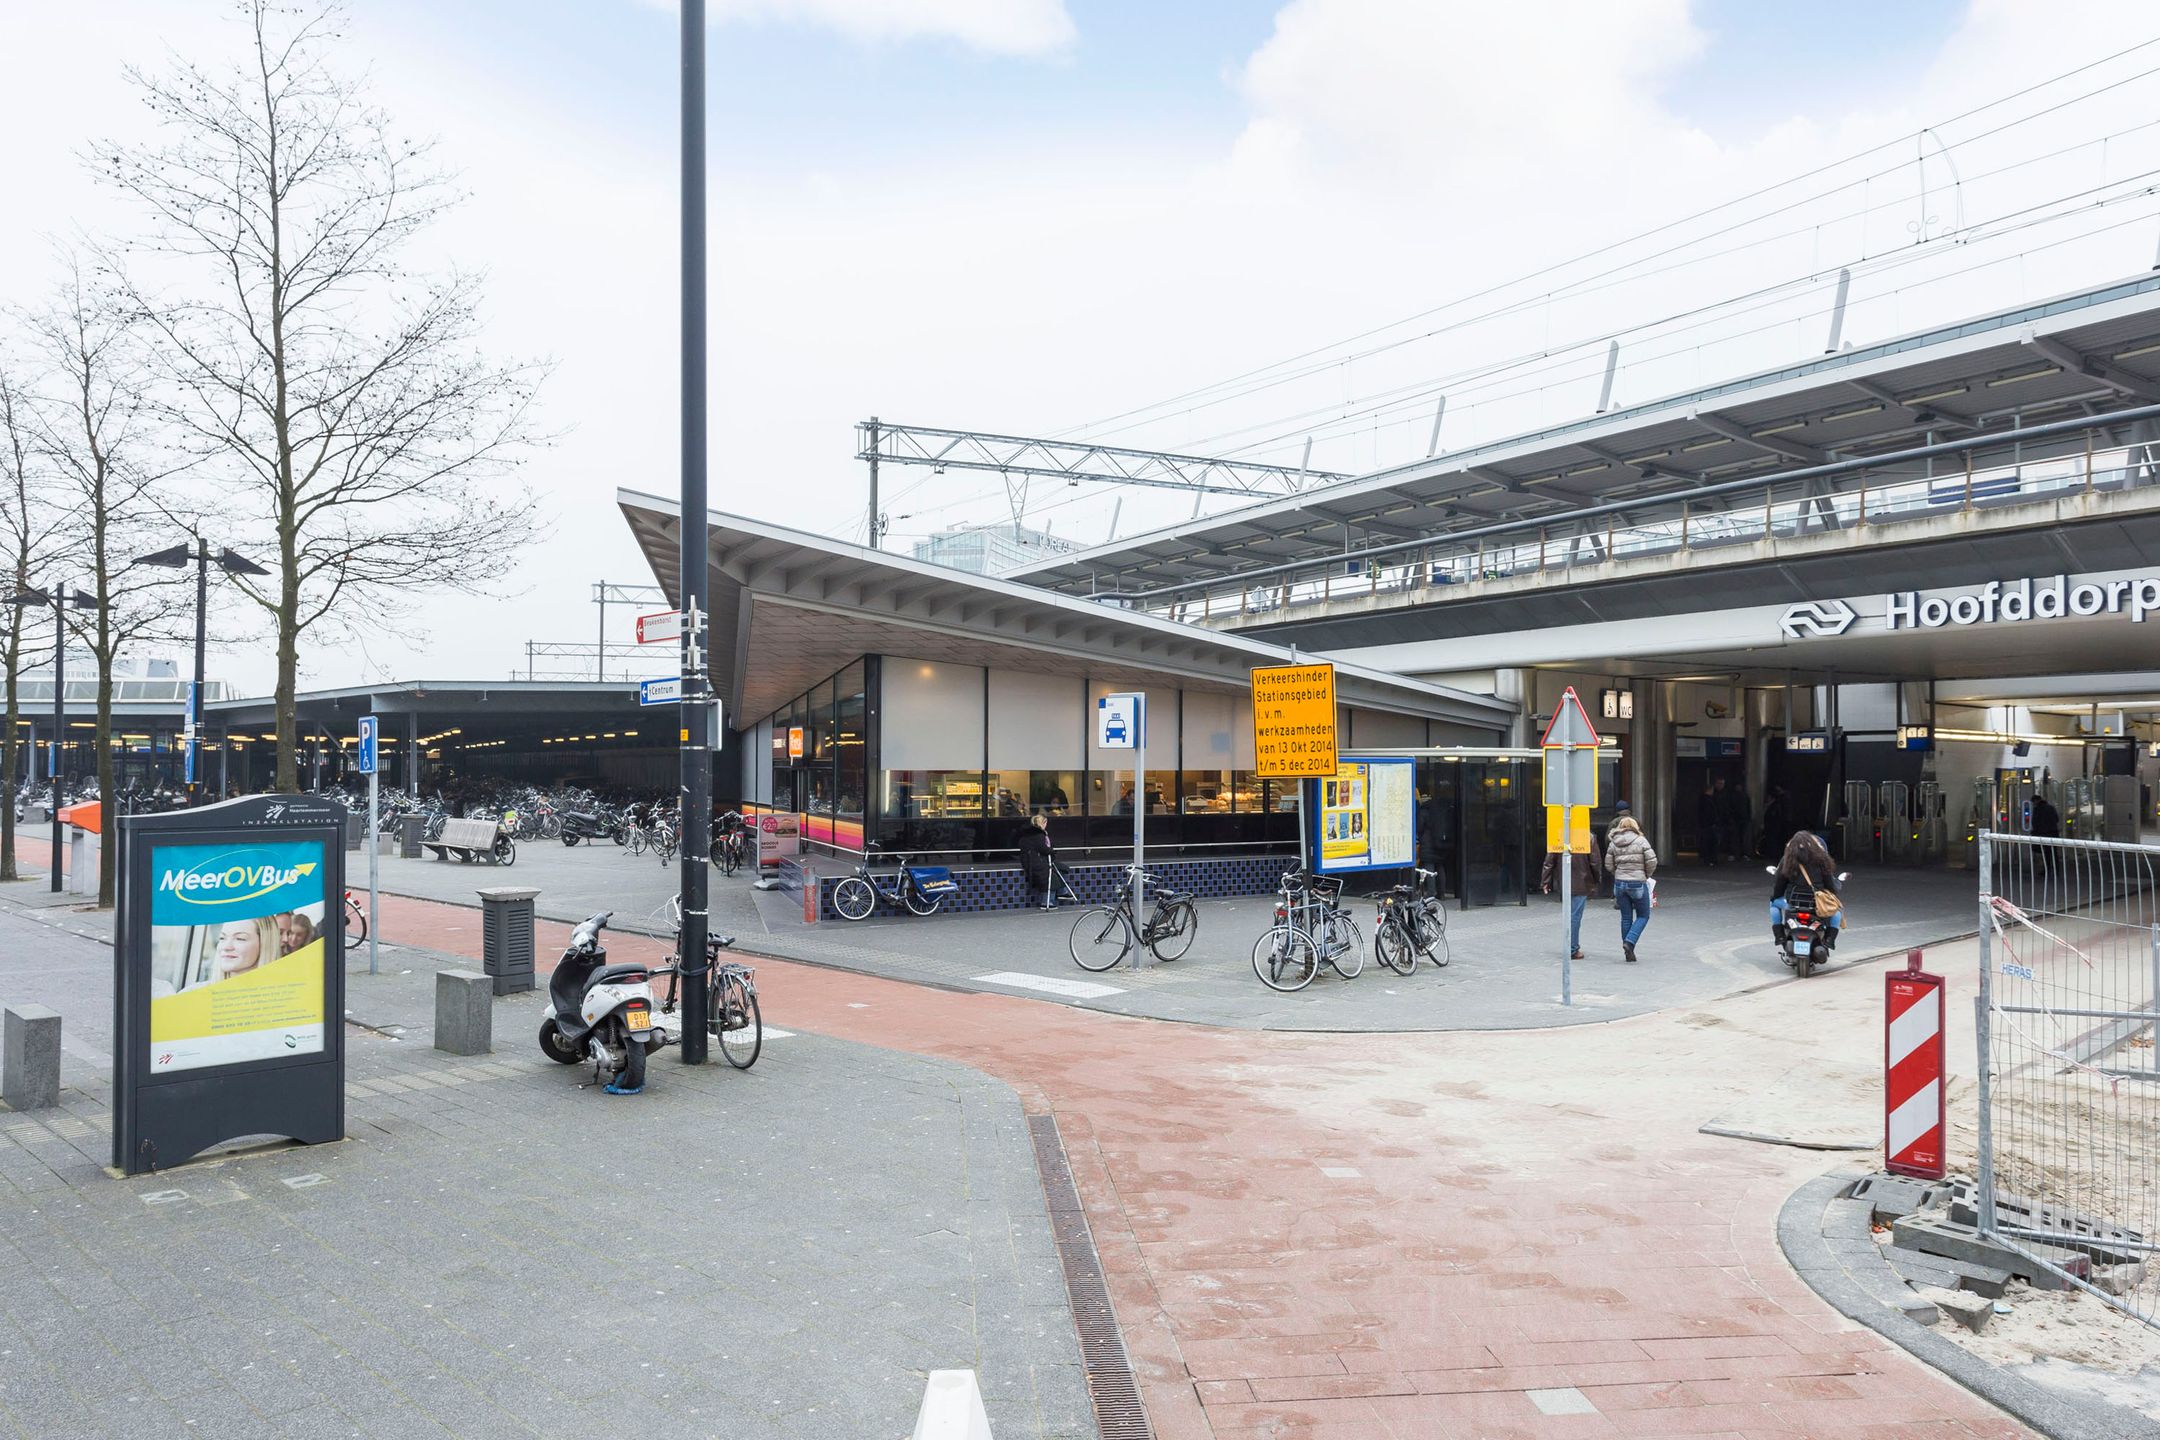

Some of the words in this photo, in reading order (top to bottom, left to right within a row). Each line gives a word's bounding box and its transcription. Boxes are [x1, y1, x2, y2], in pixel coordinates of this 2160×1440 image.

[1255, 670, 1328, 685] Verkeershinder
[1256, 687, 1327, 704] Stationsgebied
[1257, 708, 1286, 719] i.v.m.
[1621, 706, 1632, 716] WC
[361, 721, 371, 750] P
[1257, 723, 1333, 737] werkzaamheden
[1259, 744, 1275, 754] van
[1279, 741, 1288, 753] 13
[1310, 740, 1333, 752] 2014
[1259, 760, 1277, 771] t/m
[1280, 759, 1286, 771] 5
[1289, 759, 1305, 770] dec
[1308, 758, 1330, 770] 2014
[159, 865, 299, 891] MeerOVBus
[2002, 963, 2032, 979] HERAS
